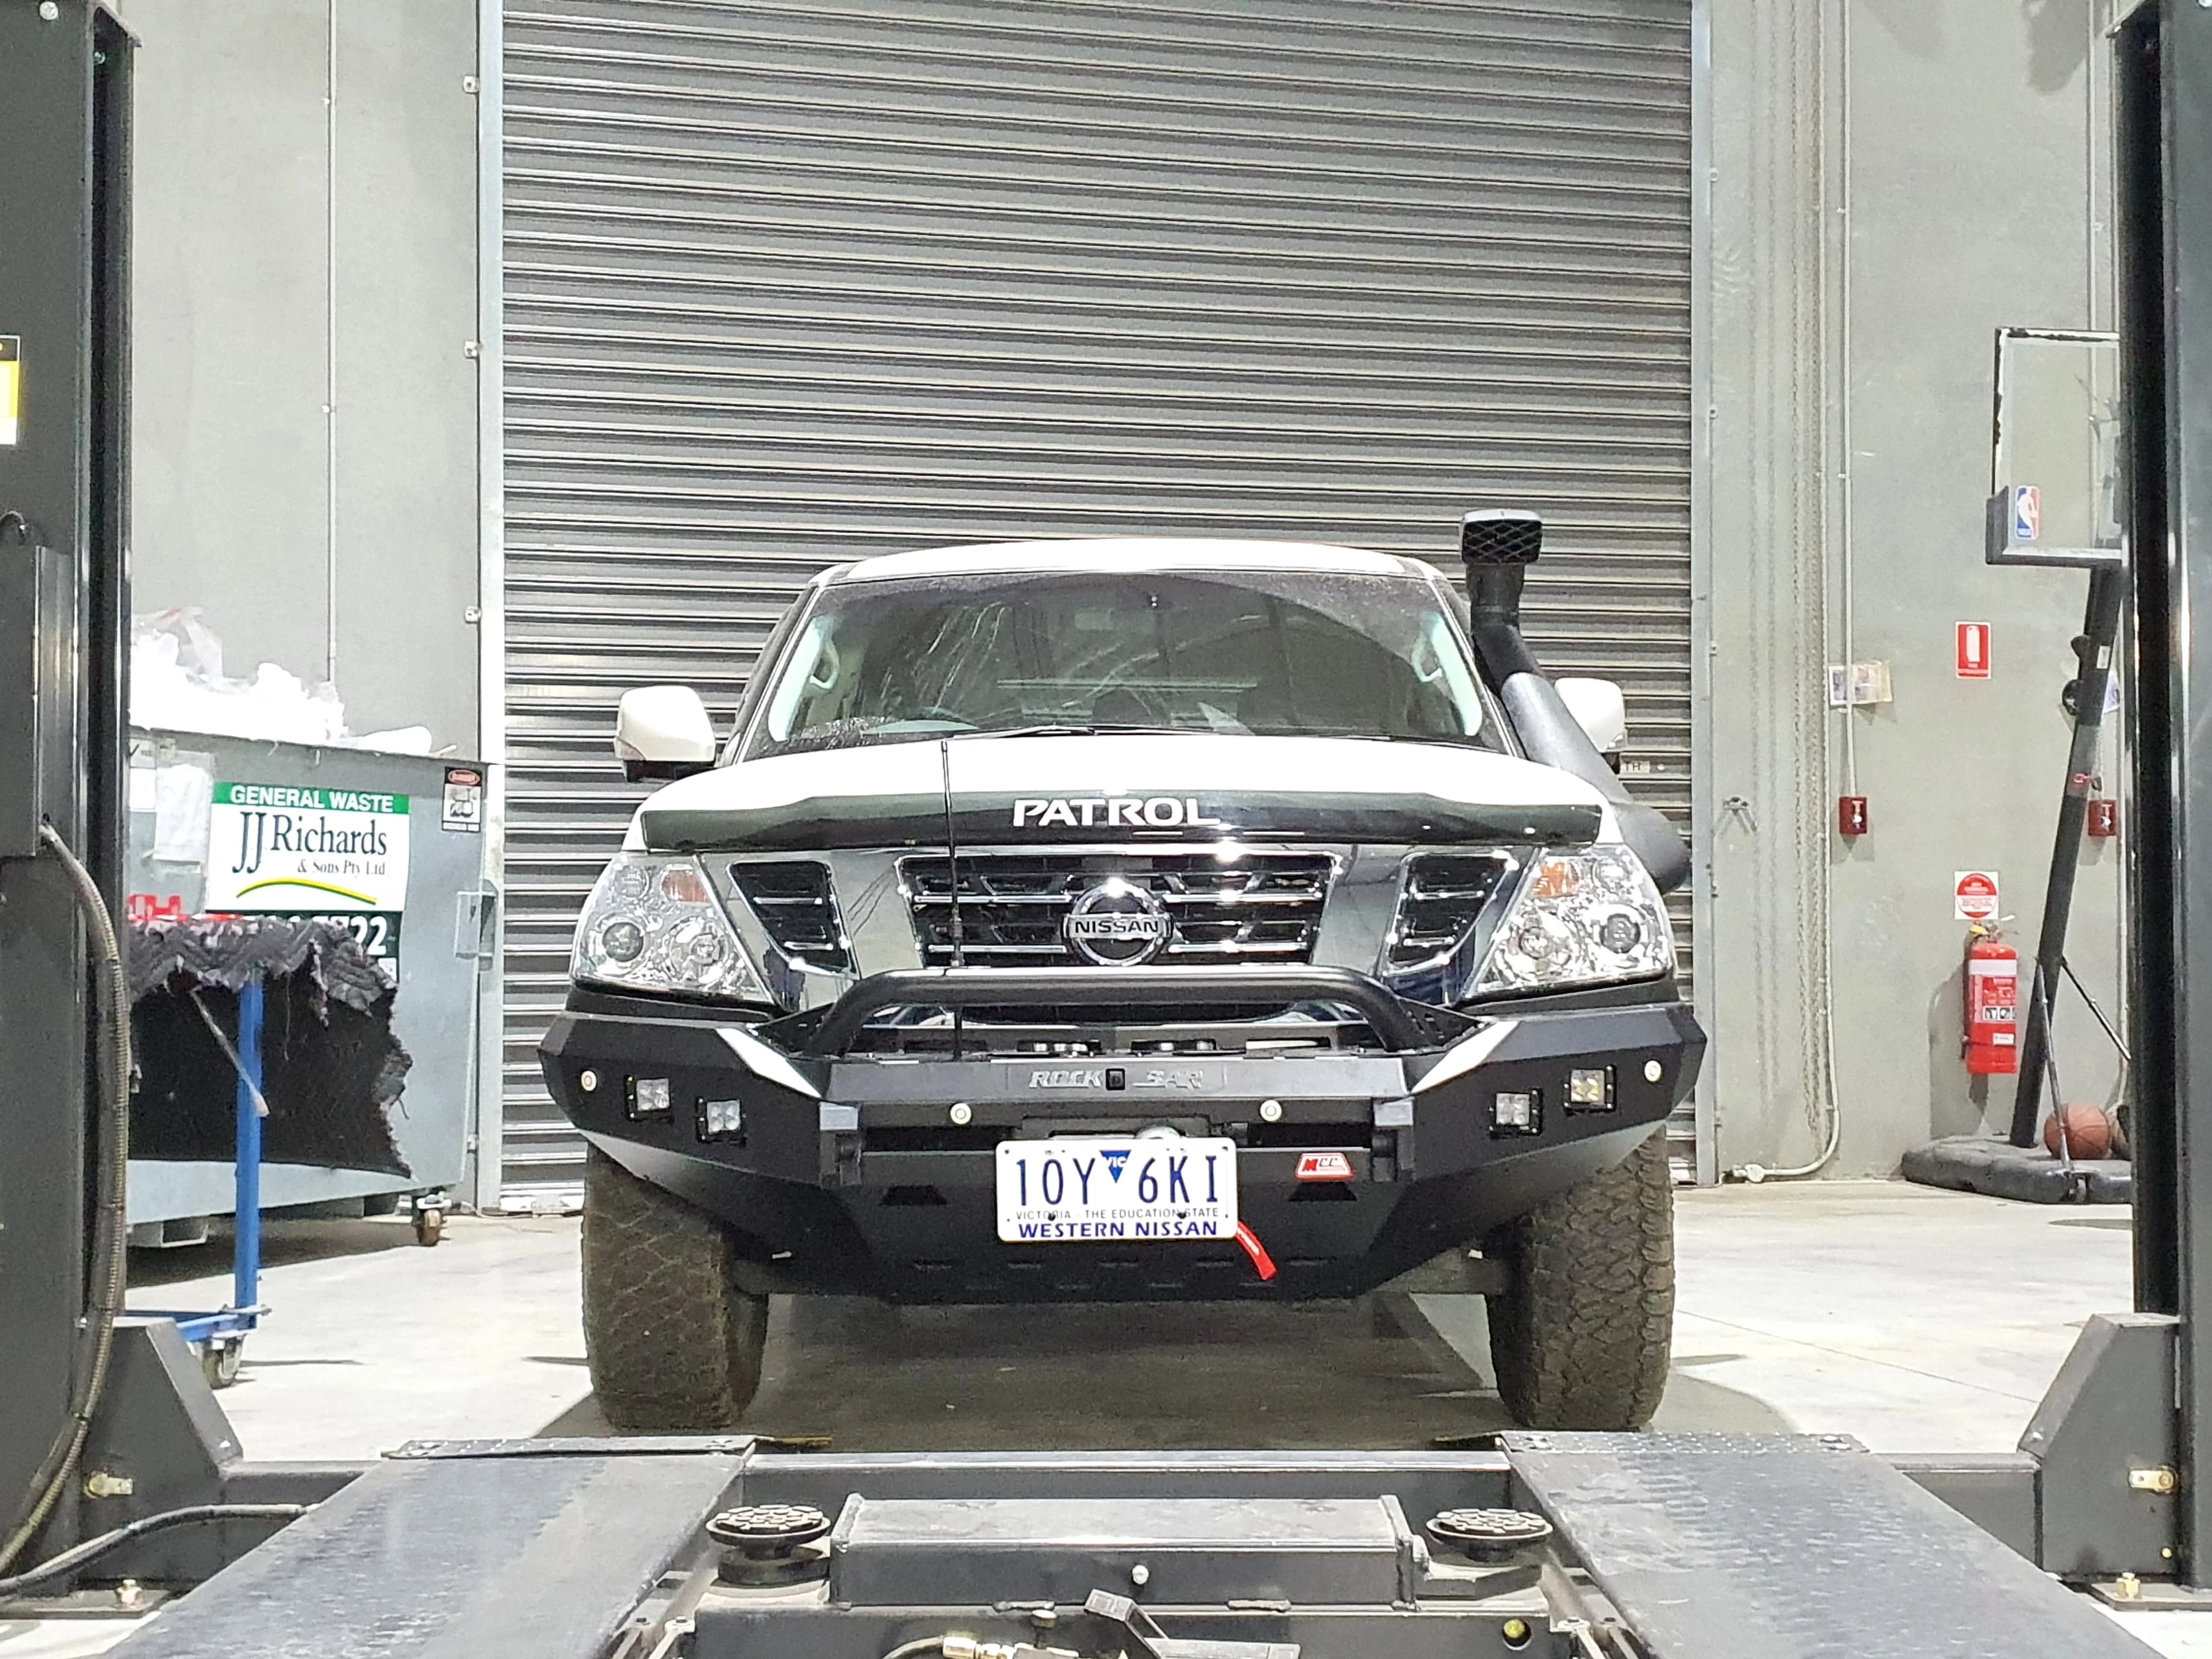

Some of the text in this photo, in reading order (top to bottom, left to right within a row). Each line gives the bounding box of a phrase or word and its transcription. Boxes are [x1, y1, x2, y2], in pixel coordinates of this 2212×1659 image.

[230, 786, 394, 812] GENERAL WASTE
[1013, 798, 1221, 826] PATROL
[270, 814, 387, 855] Richards
[297, 859, 385, 878] & Sons Pty Ltd
[1075, 920, 1159, 933] NISSAN
[1138, 1155, 1218, 1204] 6KI
[1016, 1207, 1218, 1220] VICTORIA THE EDUCATION STATE
[1018, 1221, 1217, 1238] WESTERN NISSAN
